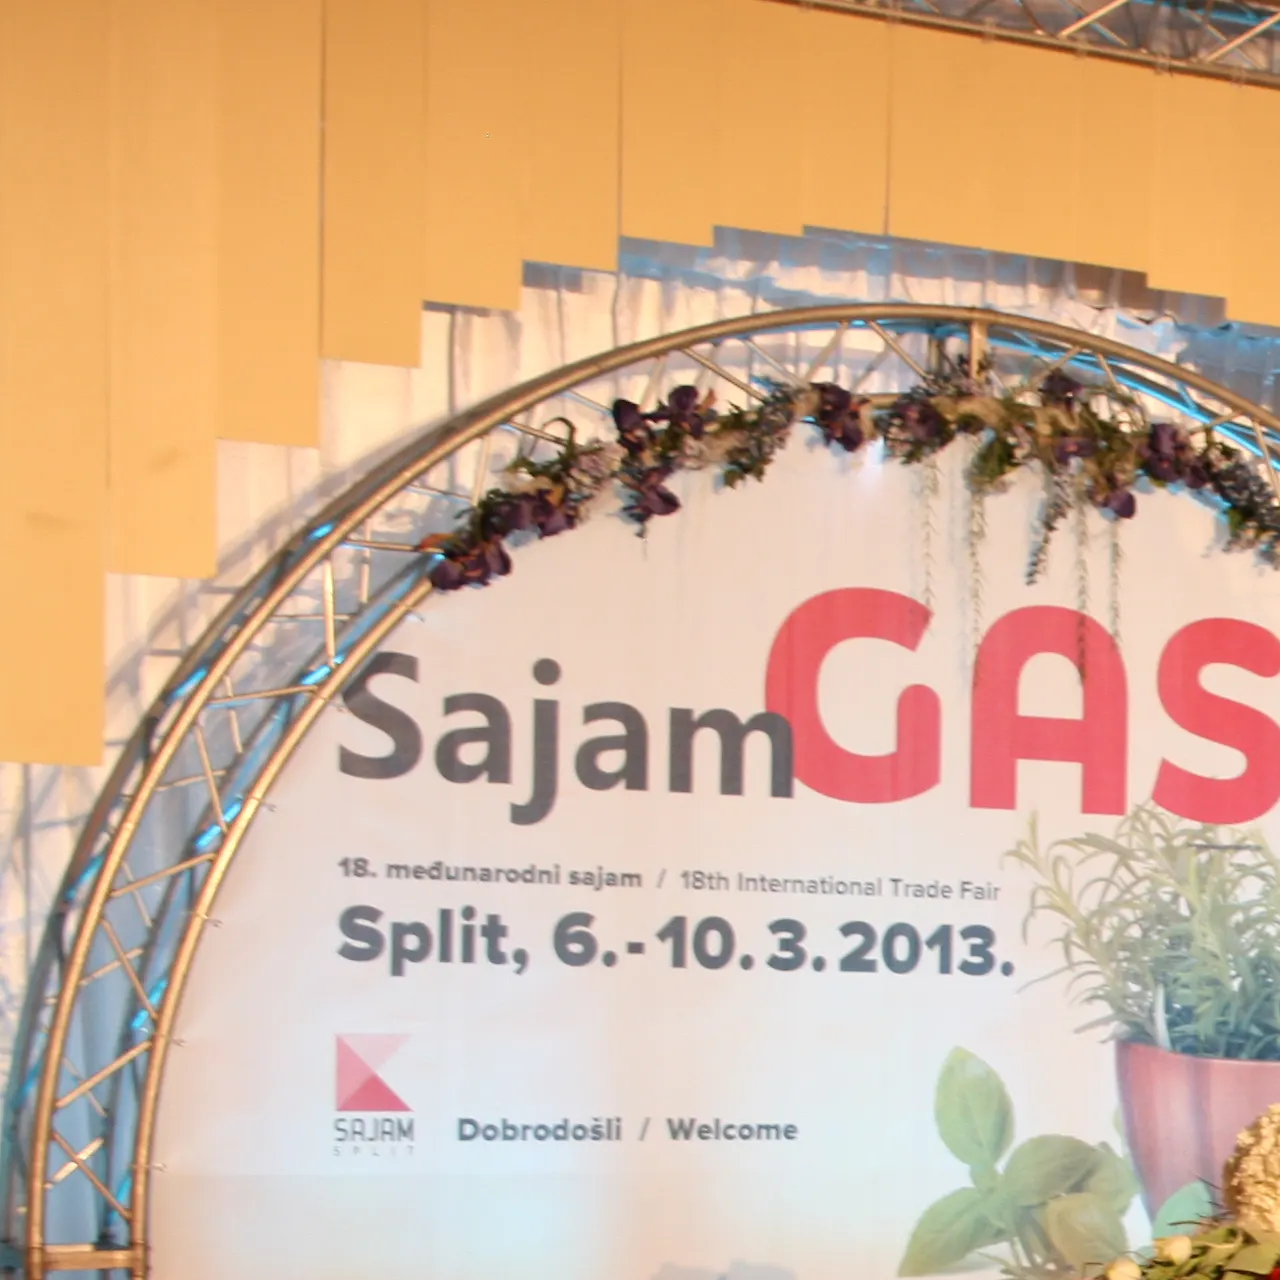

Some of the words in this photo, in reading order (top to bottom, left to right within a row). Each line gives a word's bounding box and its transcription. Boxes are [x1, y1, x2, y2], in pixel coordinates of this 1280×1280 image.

[337, 652, 796, 827] Sajam
[337, 857, 379, 879] 18.
[386, 861, 563, 885] međunarodni
[568, 866, 643, 892] sajam
[656, 867, 667, 890] /
[679, 869, 731, 892] 18th
[737, 871, 883, 897] International
[890, 877, 954, 899] Trade
[960, 880, 1001, 901] Fair
[337, 904, 530, 977] Split,
[333, 1117, 415, 1142] SAJAM
[457, 1117, 623, 1142] Dobrodošli
[638, 1117, 650, 1142] /
[666, 1117, 800, 1142] Welcome
